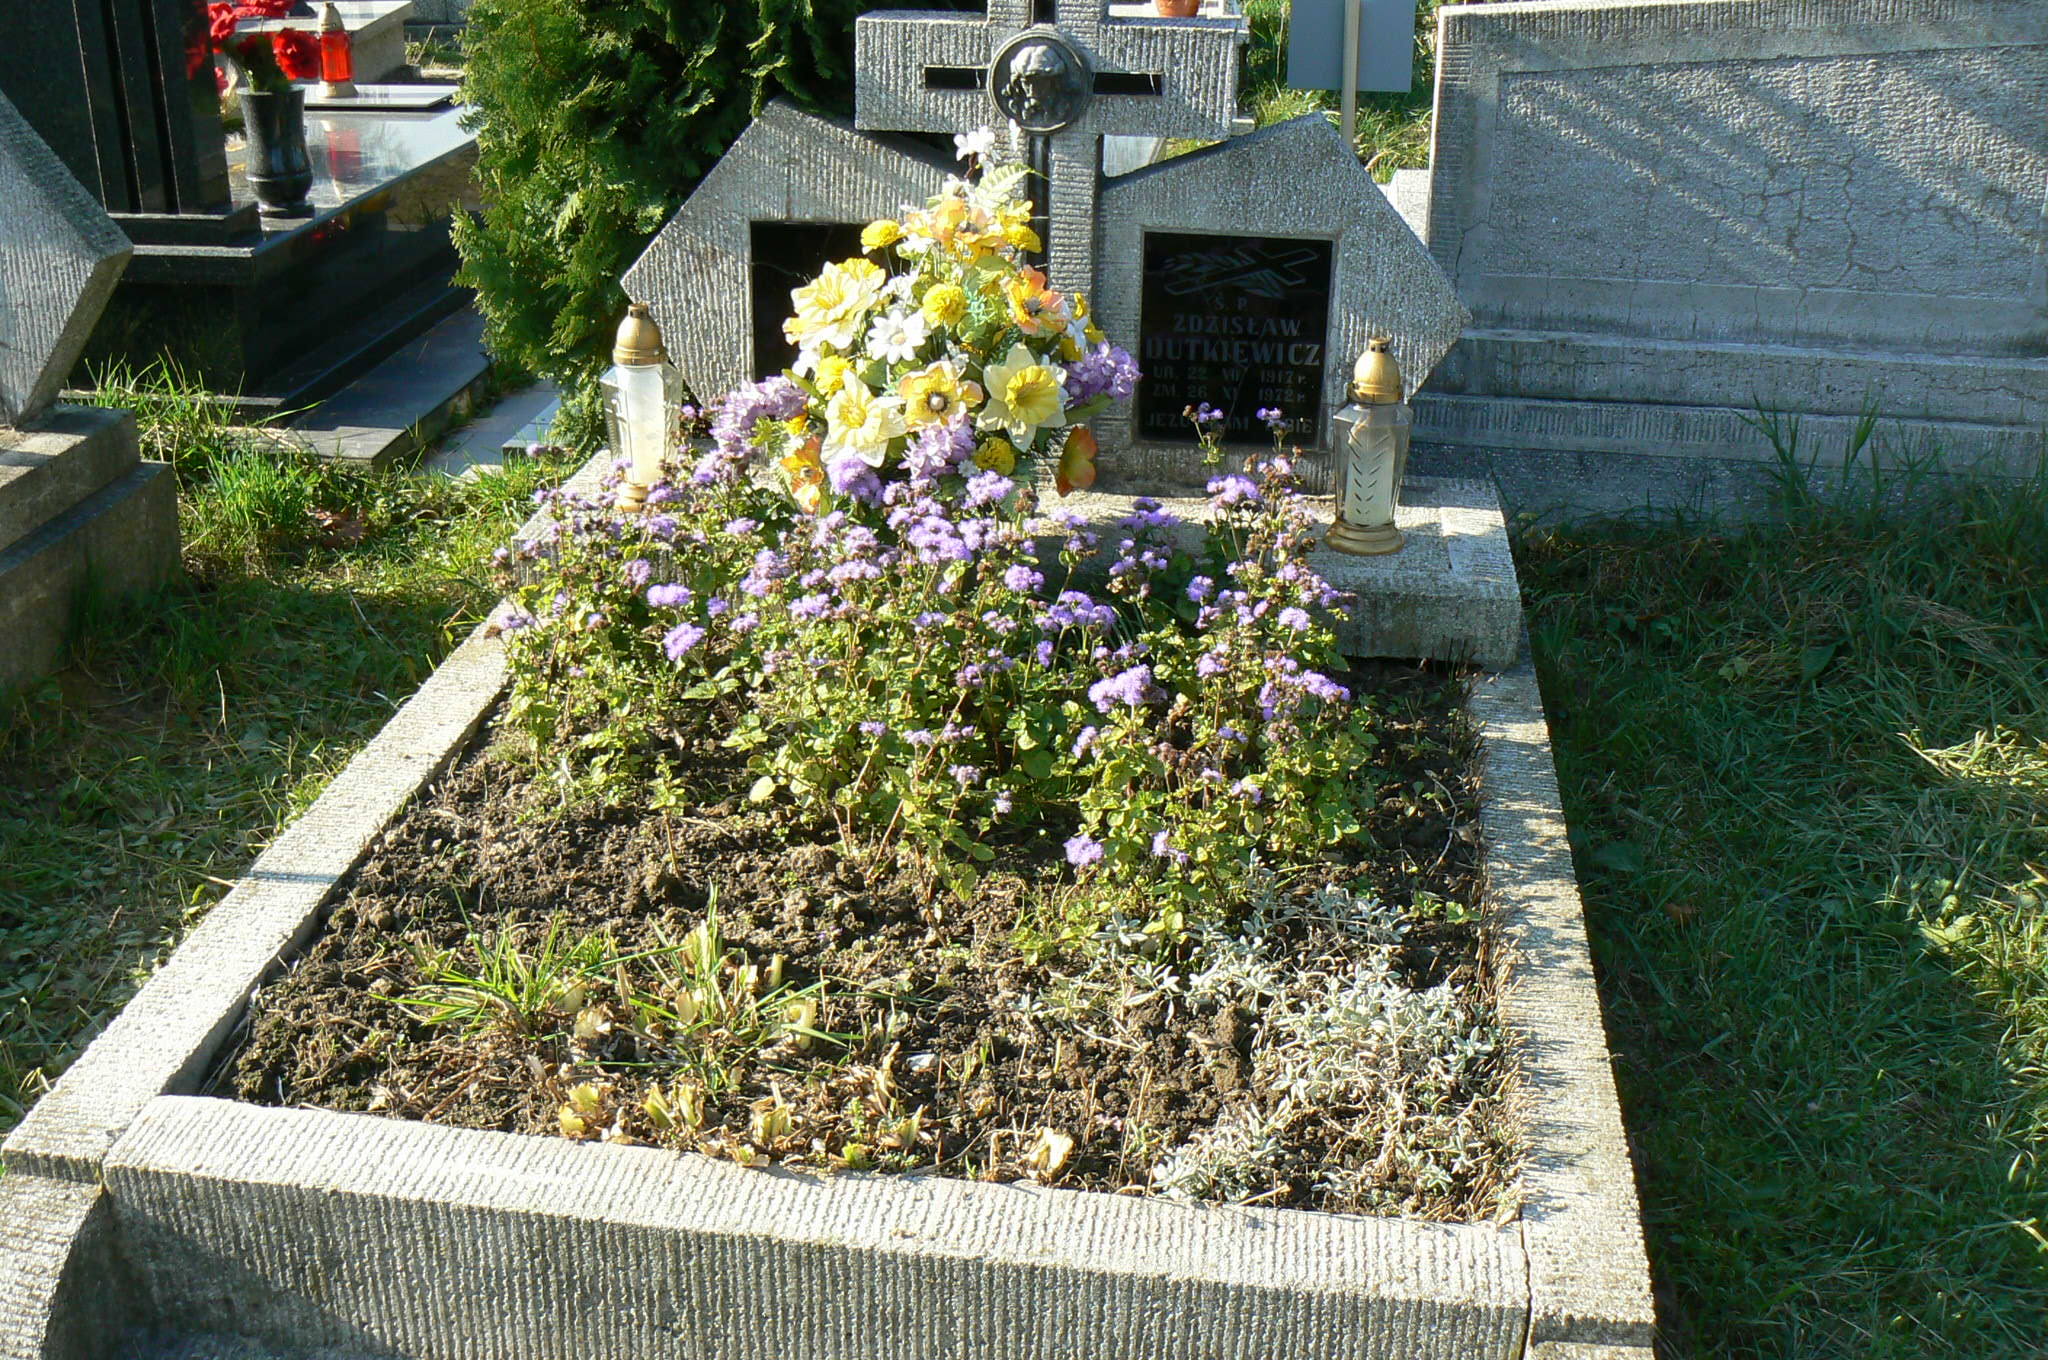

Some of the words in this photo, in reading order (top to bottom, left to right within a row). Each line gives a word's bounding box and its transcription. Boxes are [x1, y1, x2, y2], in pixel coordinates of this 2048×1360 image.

[1173, 313, 1301, 337] ZDZISŁAW
[1145, 337, 1321, 366] DUTKIEWICZ
[1186, 385, 1208, 399] 26
